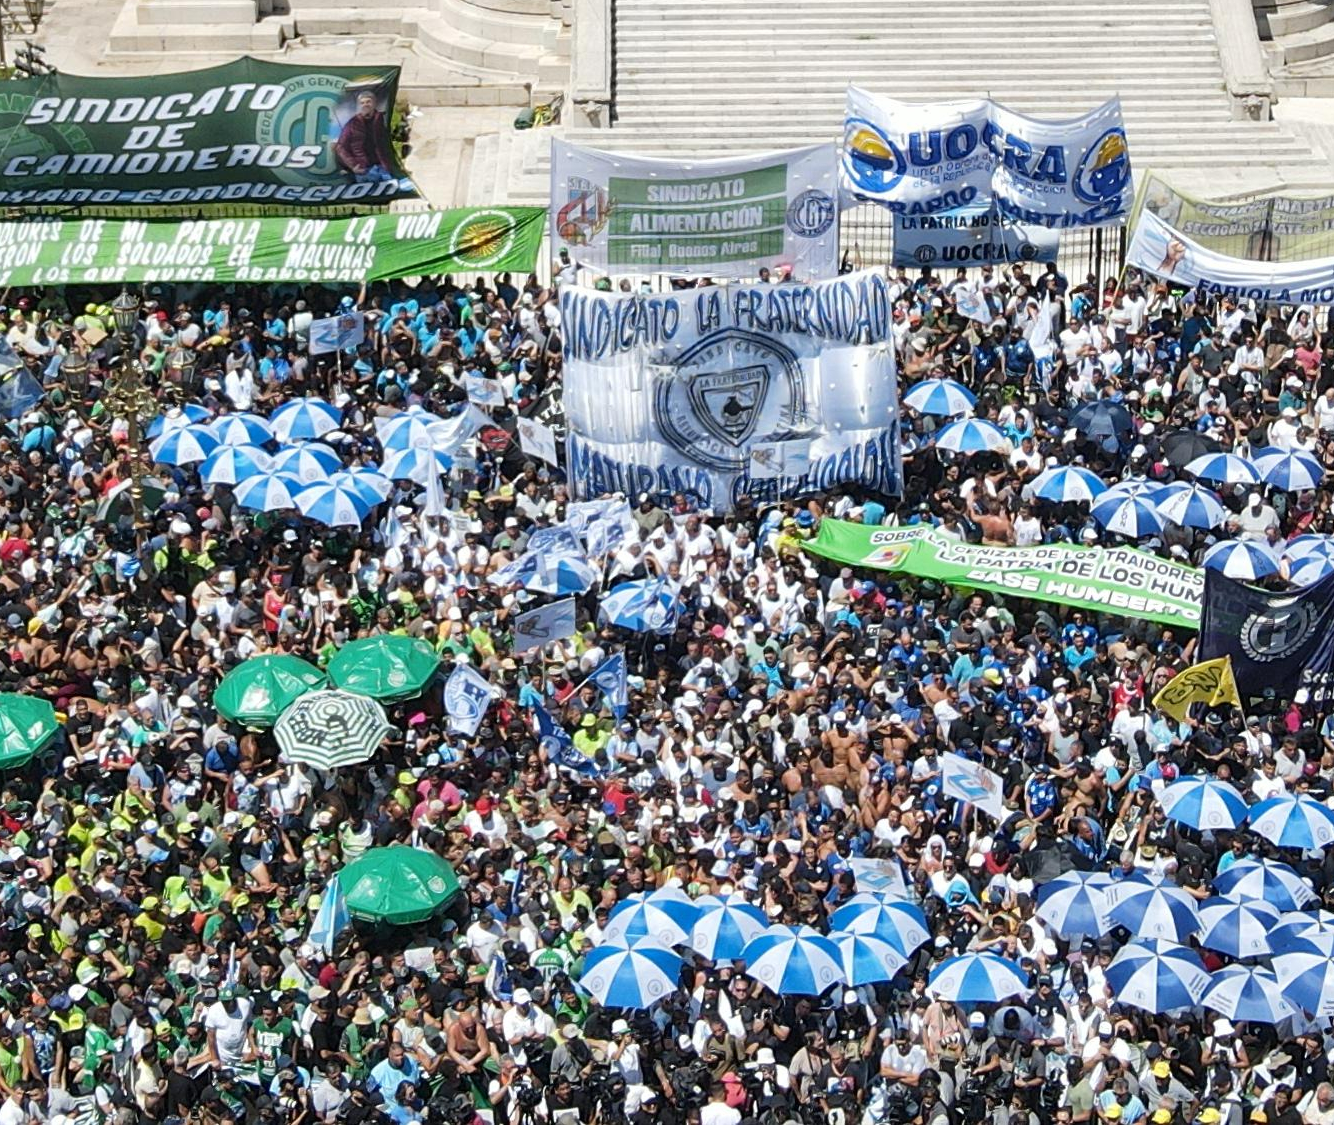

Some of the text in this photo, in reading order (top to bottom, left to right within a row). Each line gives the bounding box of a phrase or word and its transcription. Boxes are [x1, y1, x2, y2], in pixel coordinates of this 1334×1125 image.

[24, 83, 286, 126] SINDICATO
[122, 122, 195, 151] DE
[3, 142, 323, 177] CAMIONEROS
[908, 123, 1067, 184] UOCRA
[647, 178, 745, 203] SINDICATO
[79, 220, 106, 243] DE
[119, 221, 147, 243] MI
[175, 220, 262, 246] PATRIA
[283, 218, 326, 244] DOY
[343, 216, 378, 242] LA
[395, 211, 443, 240] VIDA
[630, 203, 764, 234] ALIMENTACIÓN
[902, 216, 916, 230] LA
[919, 215, 967, 229] PATRIA
[971, 214, 990, 228] NO
[59, 242, 99, 266] LOS
[117, 242, 212, 266] SOLDADOS
[225, 243, 252, 266] EN
[285, 243, 376, 269] MALVINAS
[631, 239, 759, 259] Filial Buenos Aires
[942, 243, 1011, 262] UOCRA
[31, 266, 79, 284] LOS
[83, 266, 129, 283] QUE
[143, 266, 216, 283] NUNCA
[563, 272, 893, 361] SINDICATO LA FRATERNIDAD
[873, 529, 1205, 587] SOBRE LA CENIZAS DE LOS TRAIDORES
[935, 550, 968, 566] LA
[1061, 559, 1096, 579] DE
[1099, 564, 1146, 587] LOS
[967, 569, 1202, 620] BASE HUMBERTO
